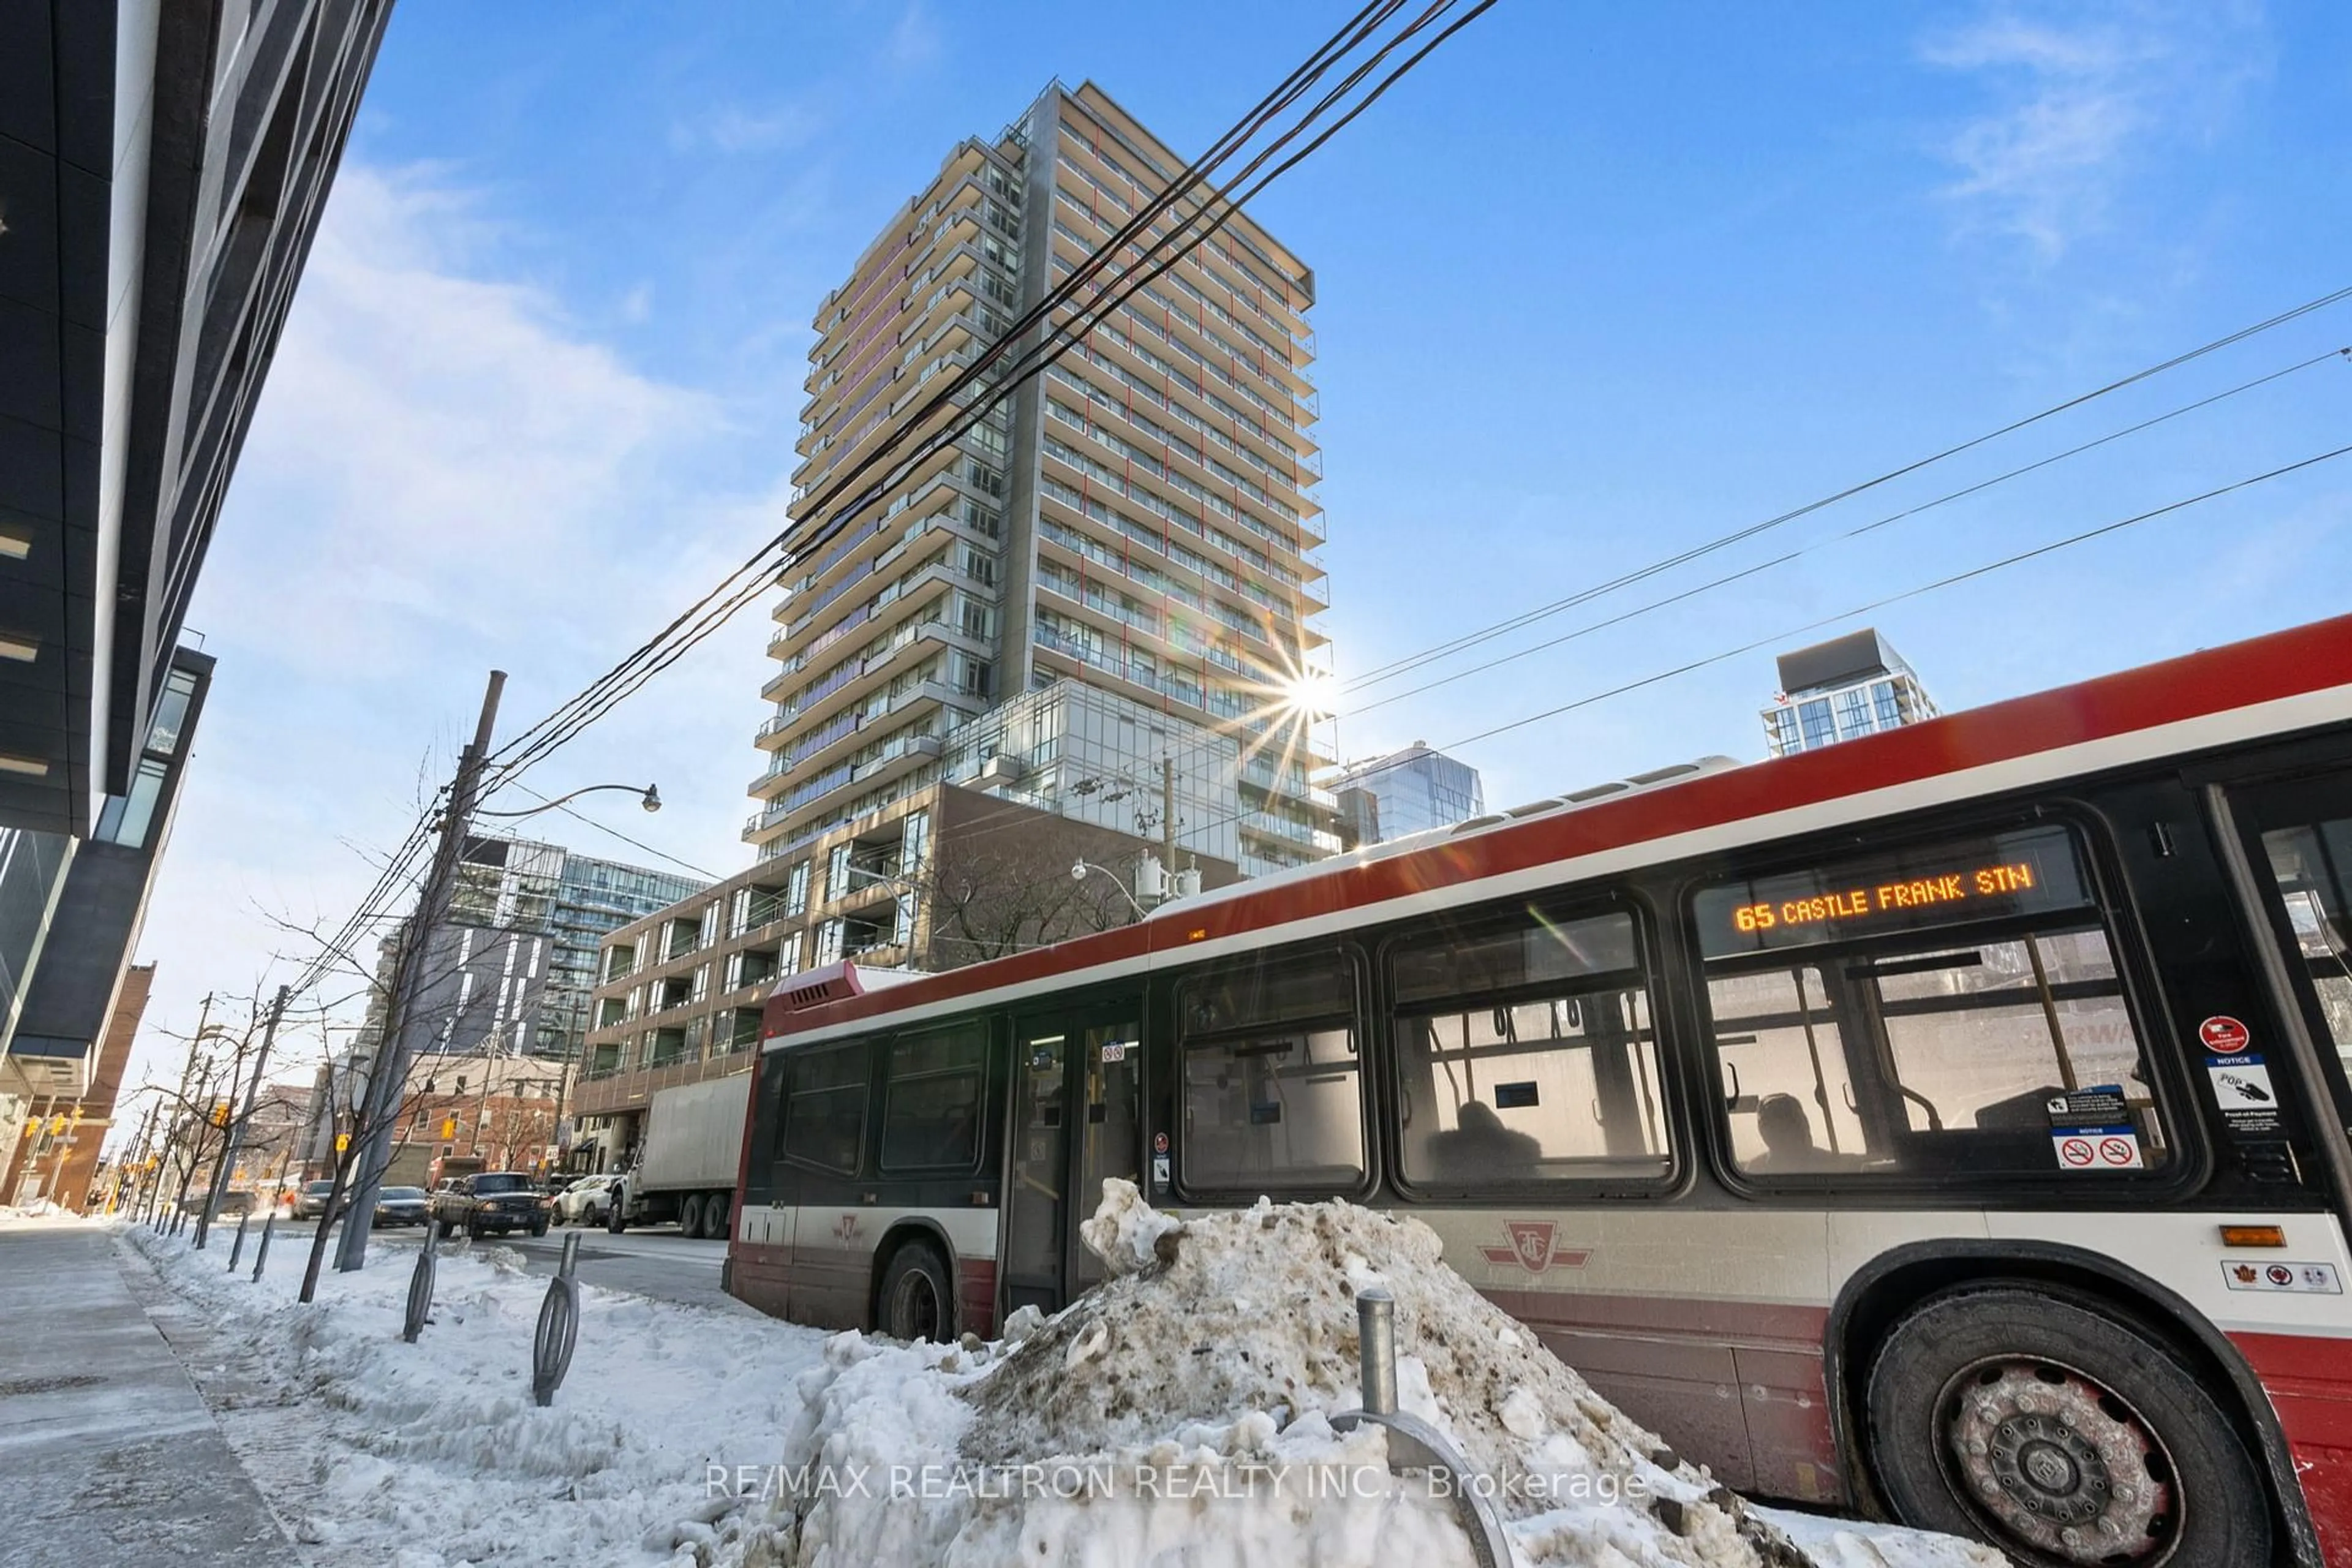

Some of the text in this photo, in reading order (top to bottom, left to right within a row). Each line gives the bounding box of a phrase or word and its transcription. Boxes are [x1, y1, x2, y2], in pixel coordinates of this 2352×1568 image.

[1736, 864, 2032, 932] 65 CASTLE FRANK STN
[2221, 1073, 2242, 1087] POP
